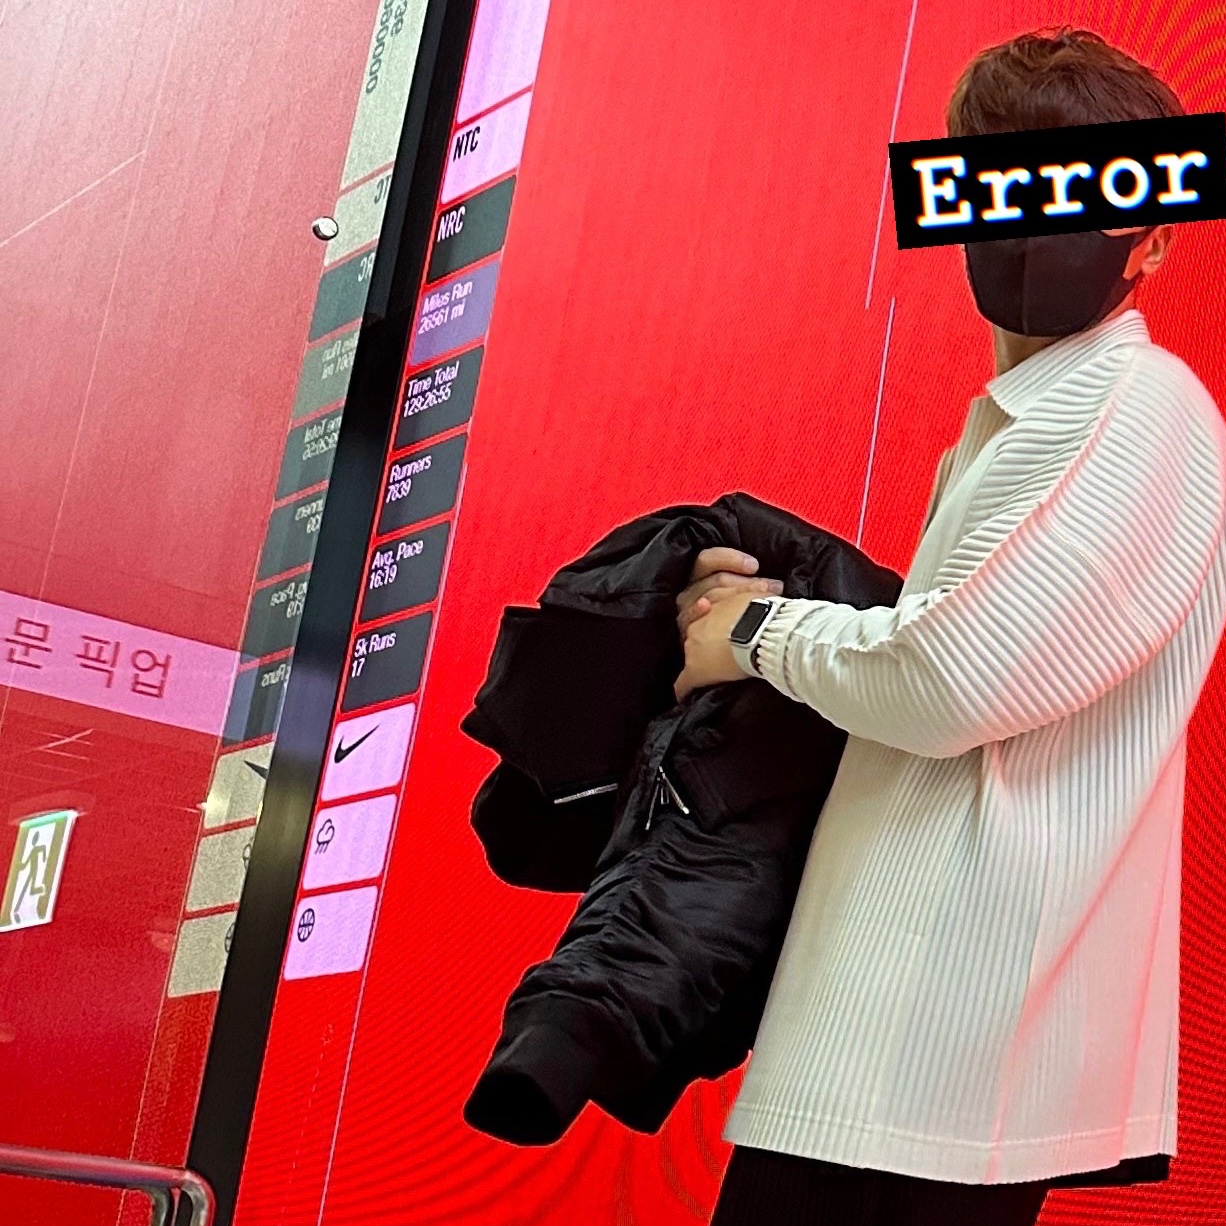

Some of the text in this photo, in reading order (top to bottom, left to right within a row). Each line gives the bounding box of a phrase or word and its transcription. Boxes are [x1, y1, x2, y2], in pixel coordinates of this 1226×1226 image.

[453, 126, 481, 163] NTC
[437, 205, 466, 243] NRC
[422, 281, 474, 316] Miles Run
[450, 298, 466, 321] mi
[408, 360, 460, 398] Time Total
[389, 455, 432, 484] Runners
[385, 478, 412, 504] 7839
[371, 540, 424, 571] Avg. Pace
[369, 565, 397, 590] 16:19
[354, 632, 397, 658] 5k Runs
[75, 634, 172, 699] 픽업
[351, 657, 366, 678] 17
